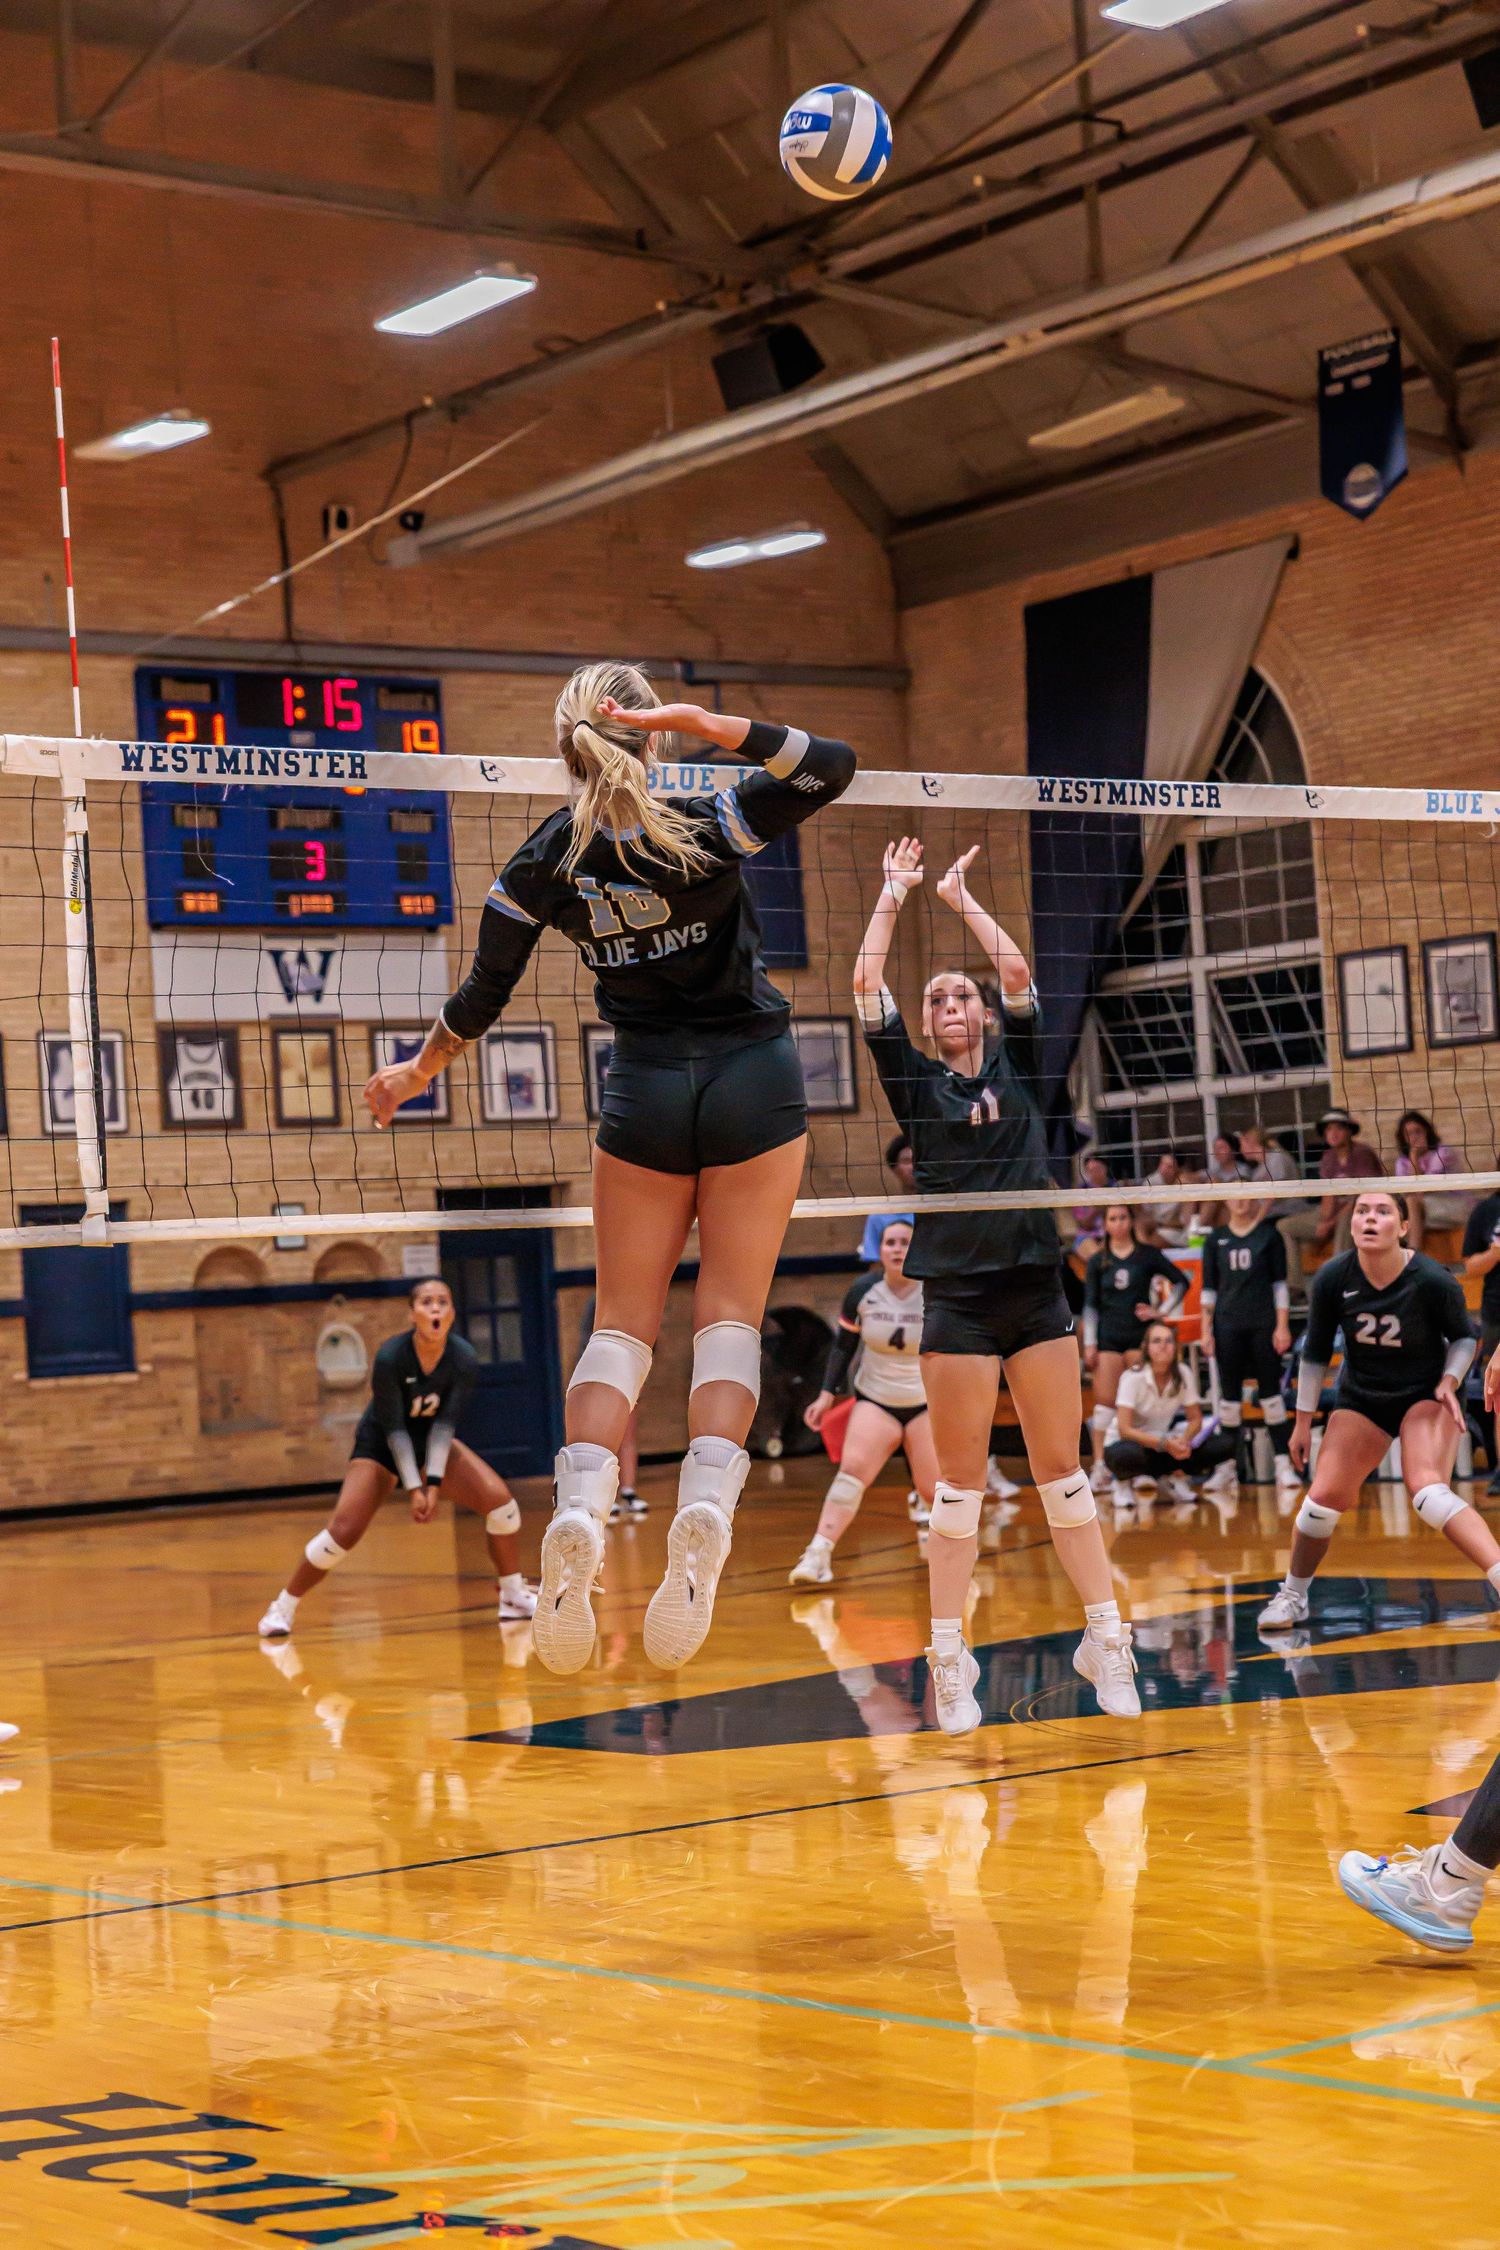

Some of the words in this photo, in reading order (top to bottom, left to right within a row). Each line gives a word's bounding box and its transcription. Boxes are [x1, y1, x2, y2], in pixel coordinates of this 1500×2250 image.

[282, 678, 363, 732] 1:15
[119, 743, 369, 780] WESTMINSTER
[647, 766, 715, 792] BLUE
[1037, 778, 1221, 808] WESTMINSTER
[1426, 792, 1483, 814] BLUE
[304, 841, 326, 881] 3
[647, 921, 708, 960] JAYS
[888, 1327, 906, 1350] 4
[1356, 1312, 1403, 1347] 22
[409, 1392, 441, 1418] 12
